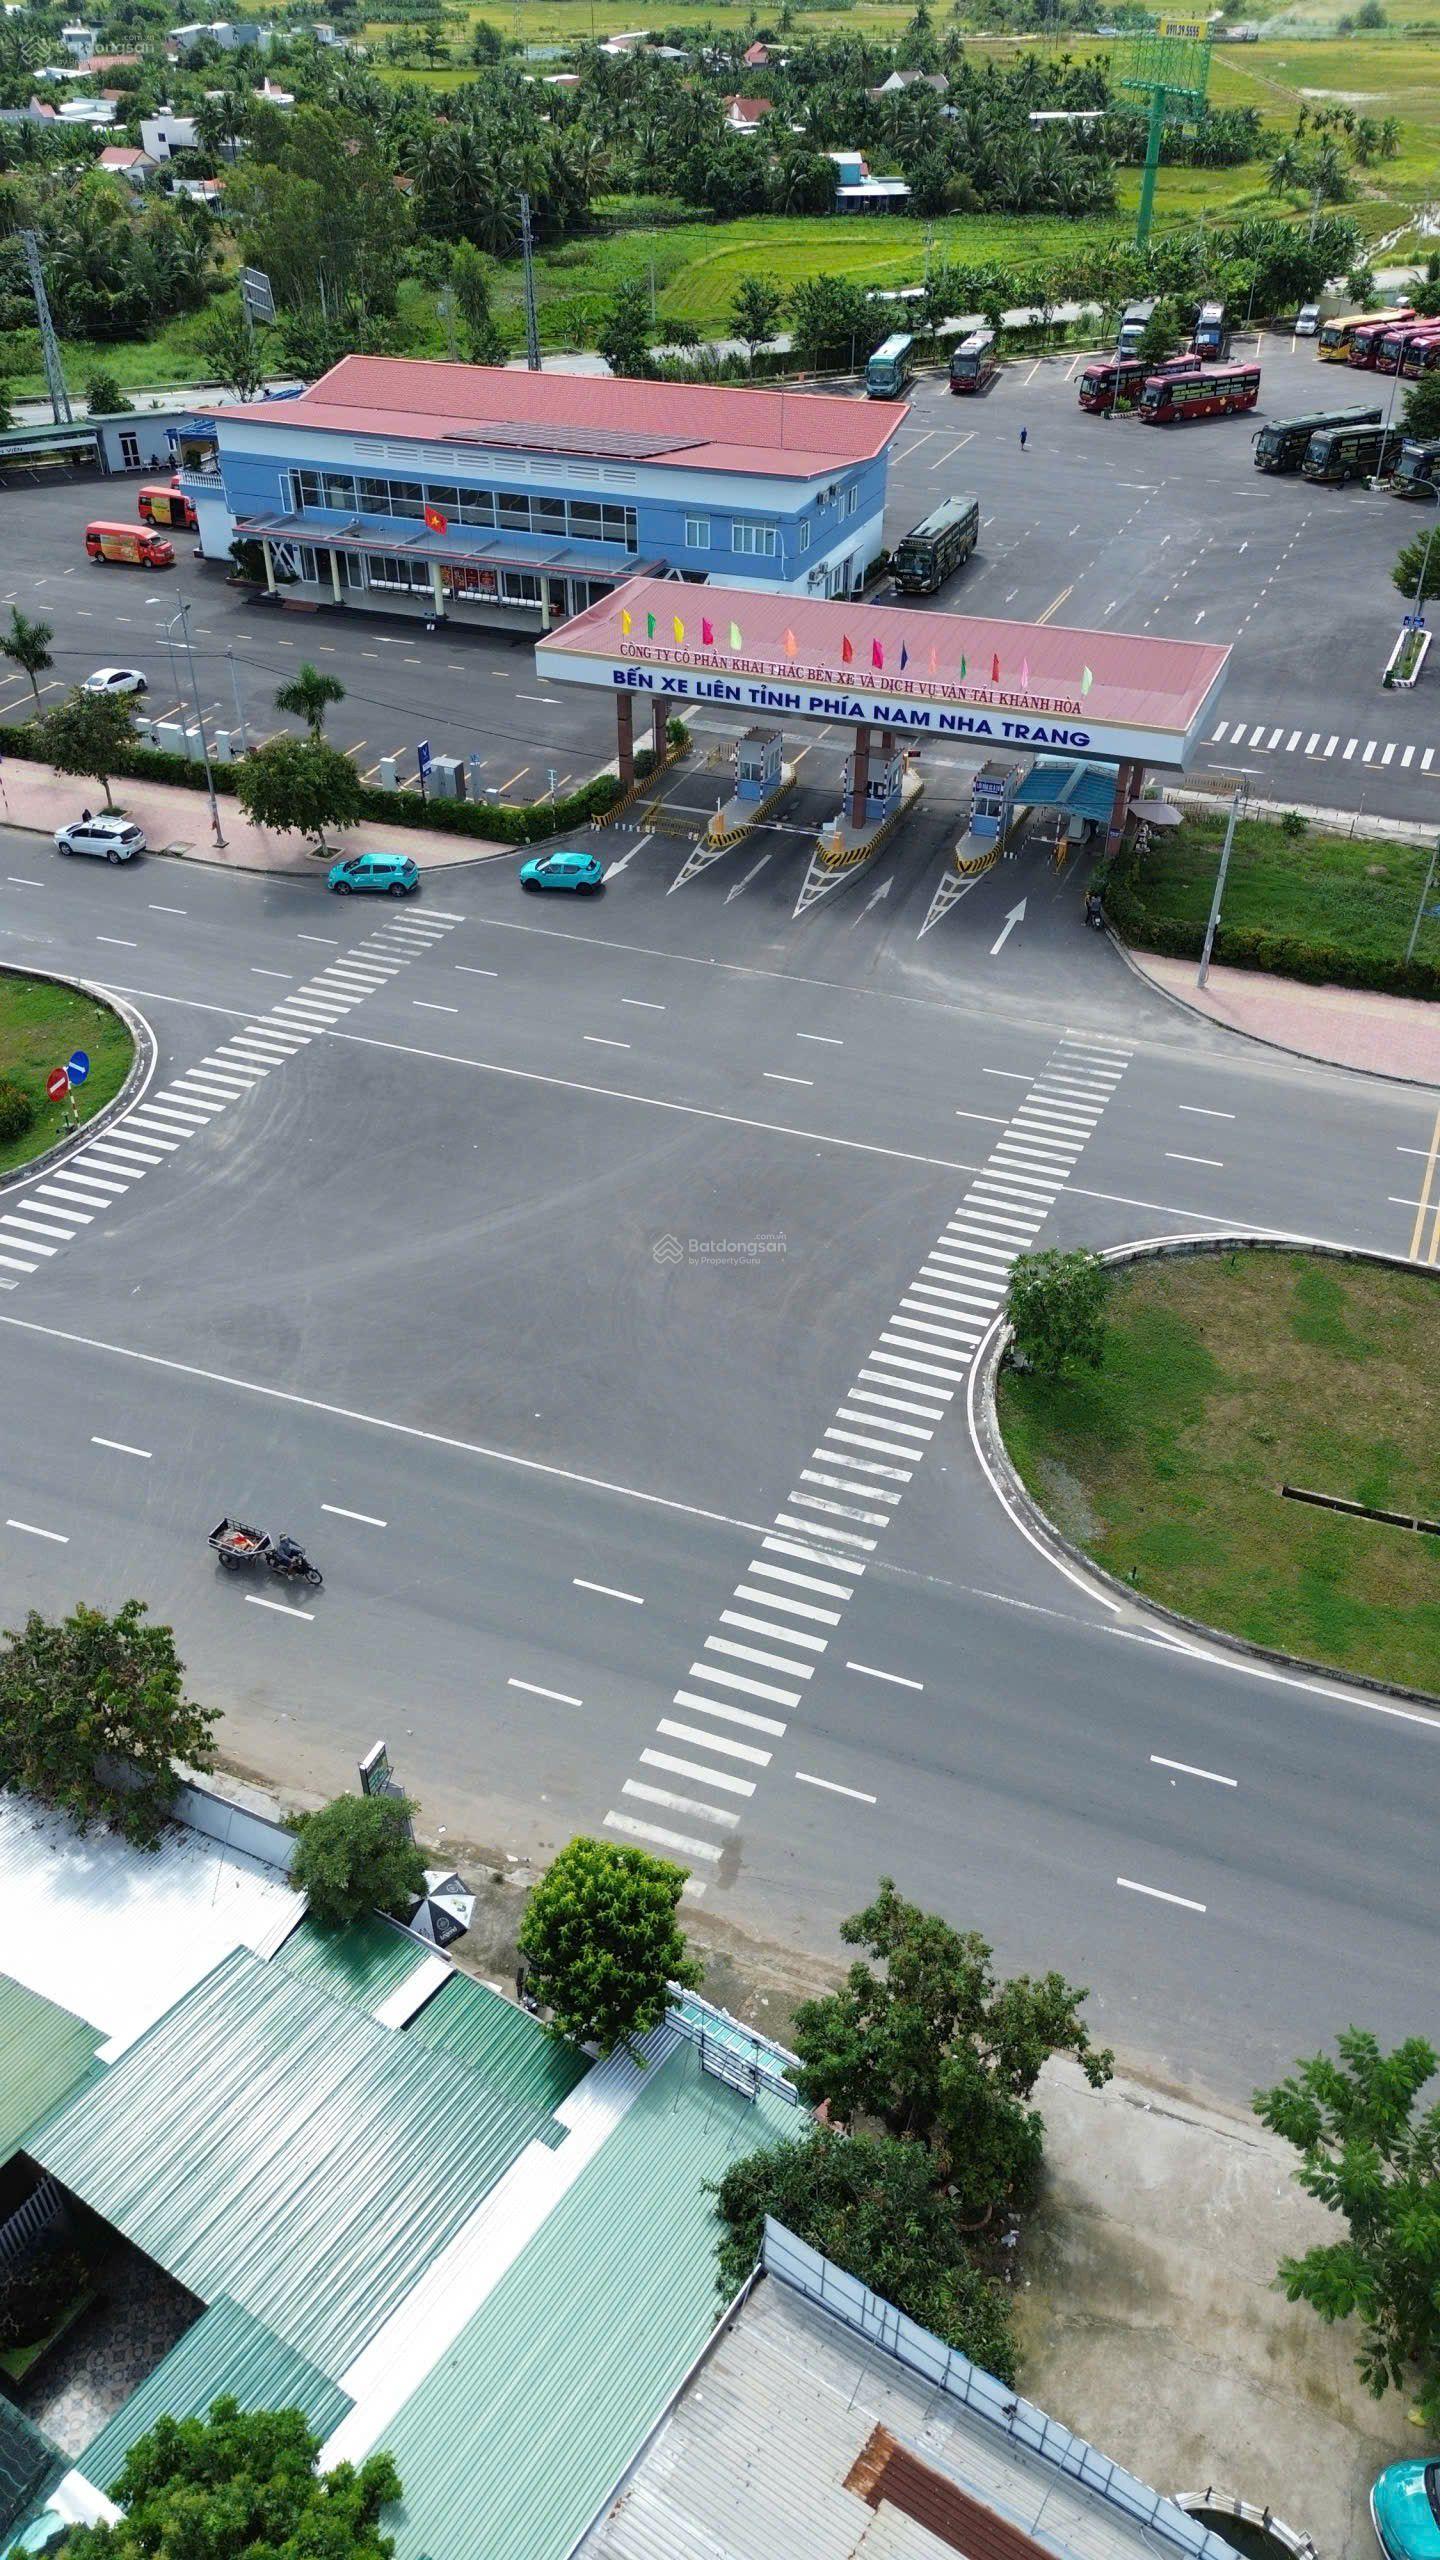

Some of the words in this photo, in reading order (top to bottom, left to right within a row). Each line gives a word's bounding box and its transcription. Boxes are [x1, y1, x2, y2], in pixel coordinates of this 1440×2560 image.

[613, 667, 653, 689] BẾN
[661, 676, 688, 694] XE
[696, 680, 741, 700] LIÊN
[748, 684, 800, 709] TỈNH
[809, 695, 865, 718] PHÍA
[873, 705, 931, 727] NAM
[939, 714, 993, 735] NHA
[1001, 721, 1091, 747] TRANG
[620, 641, 651, 658] CÔNG
[655, 649, 670, 661] TY
[732, 659, 765, 673] KHAI
[769, 661, 804, 680] THÁC
[807, 663, 832, 682] BẾN
[837, 673, 855, 686] XE
[860, 672, 875, 688] VÀ
[880, 678, 914, 694] DỊCH
[920, 683, 936, 698] VỤ
[971, 685, 994, 703] TẢI
[999, 691, 1050, 711] KHÁNH
[1054, 696, 1082, 714] HÒA
